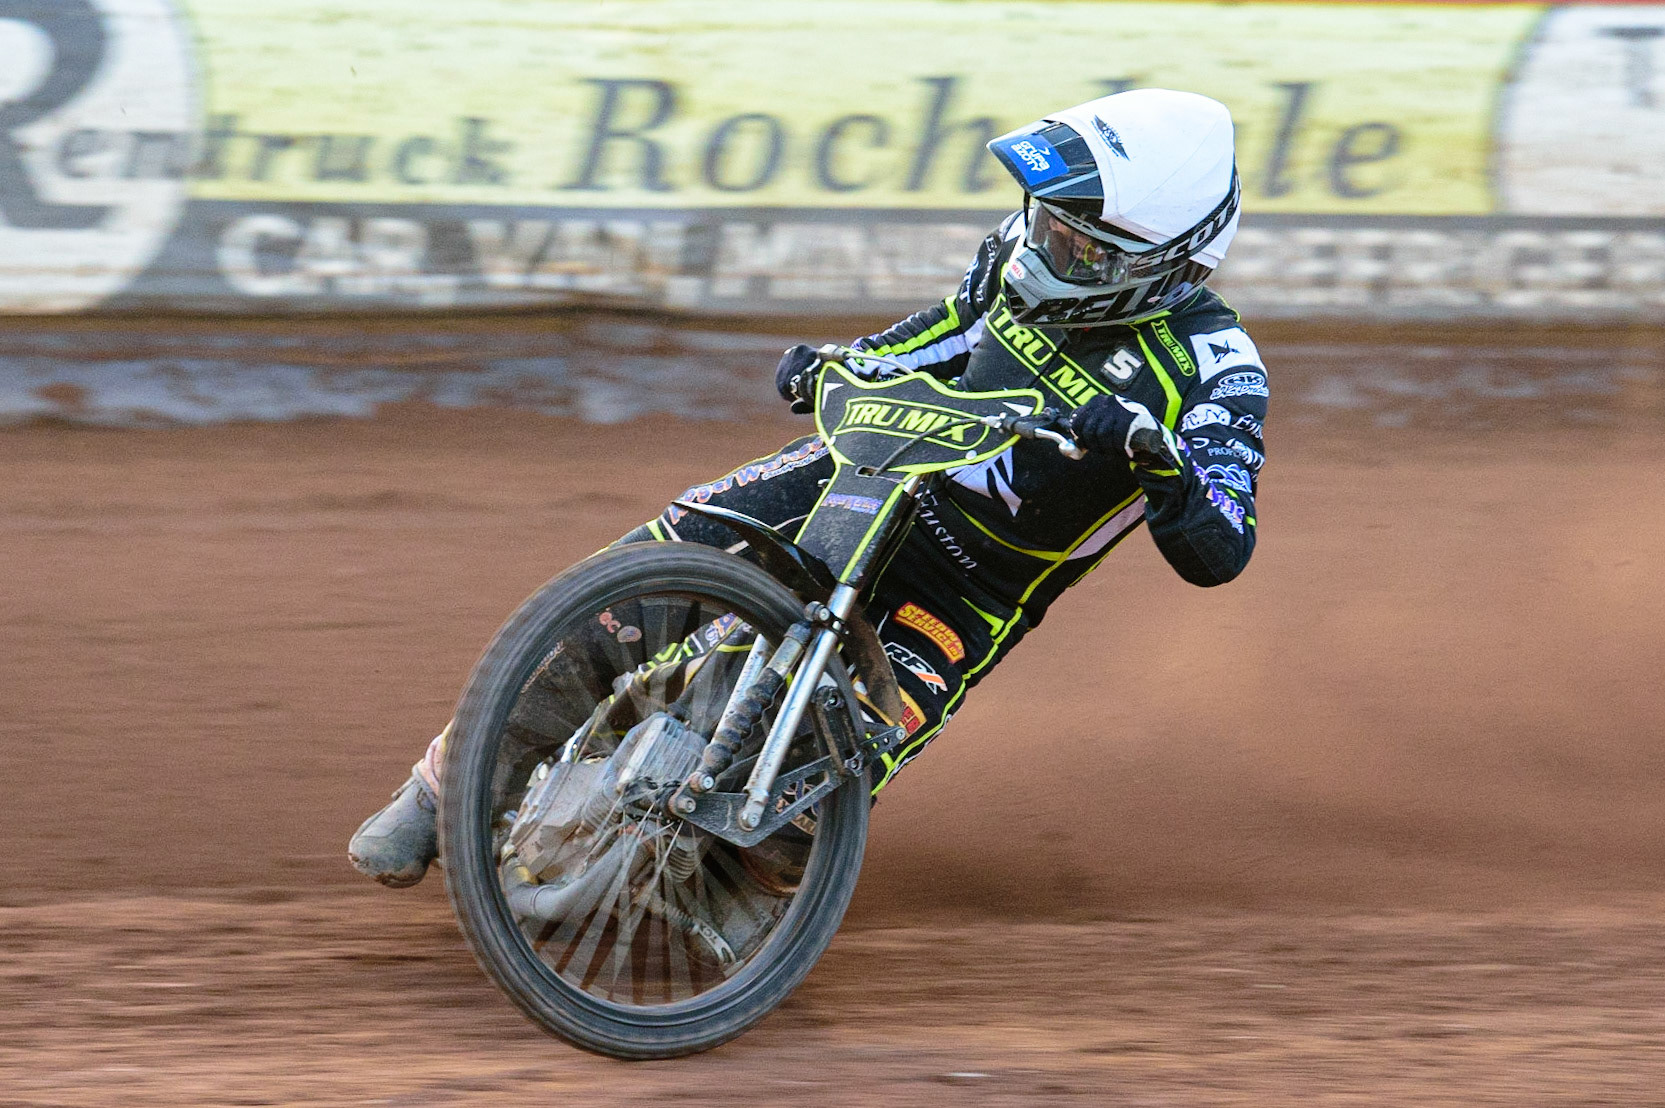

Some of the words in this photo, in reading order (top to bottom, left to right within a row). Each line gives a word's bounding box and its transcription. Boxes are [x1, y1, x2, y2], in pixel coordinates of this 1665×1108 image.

[560, 74, 1408, 200] Rochle
[992, 306, 1053, 366] TRU
[1049, 364, 1099, 406] MI
[846, 403, 904, 427] TRU
